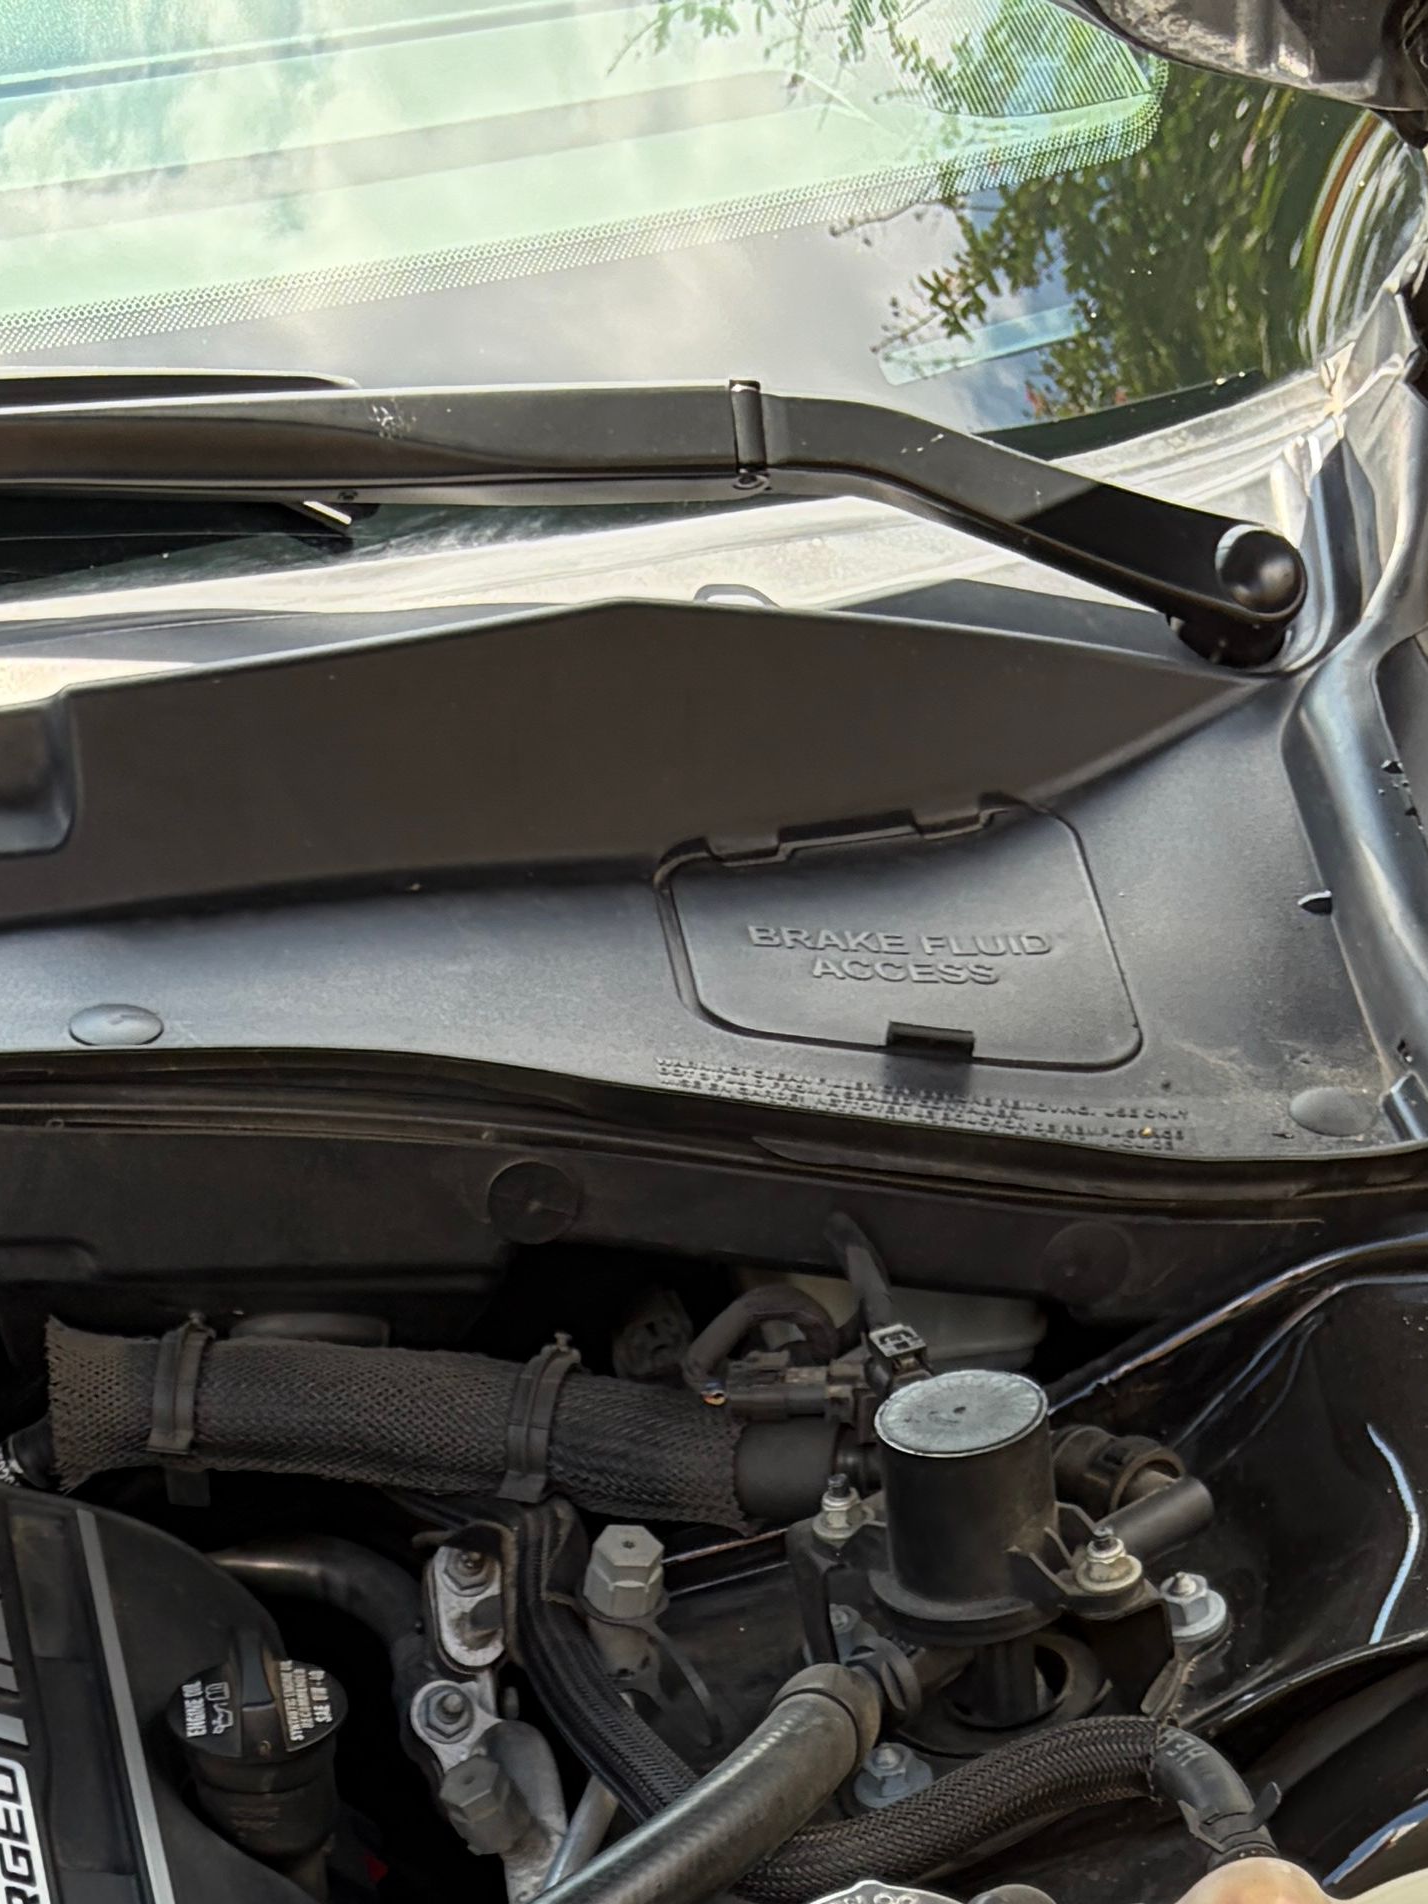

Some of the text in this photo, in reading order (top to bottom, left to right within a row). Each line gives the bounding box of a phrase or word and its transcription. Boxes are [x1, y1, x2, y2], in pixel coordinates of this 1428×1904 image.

[747, 923, 1053, 958] BRAKE FLUID
[811, 956, 1000, 985] ACCESS
